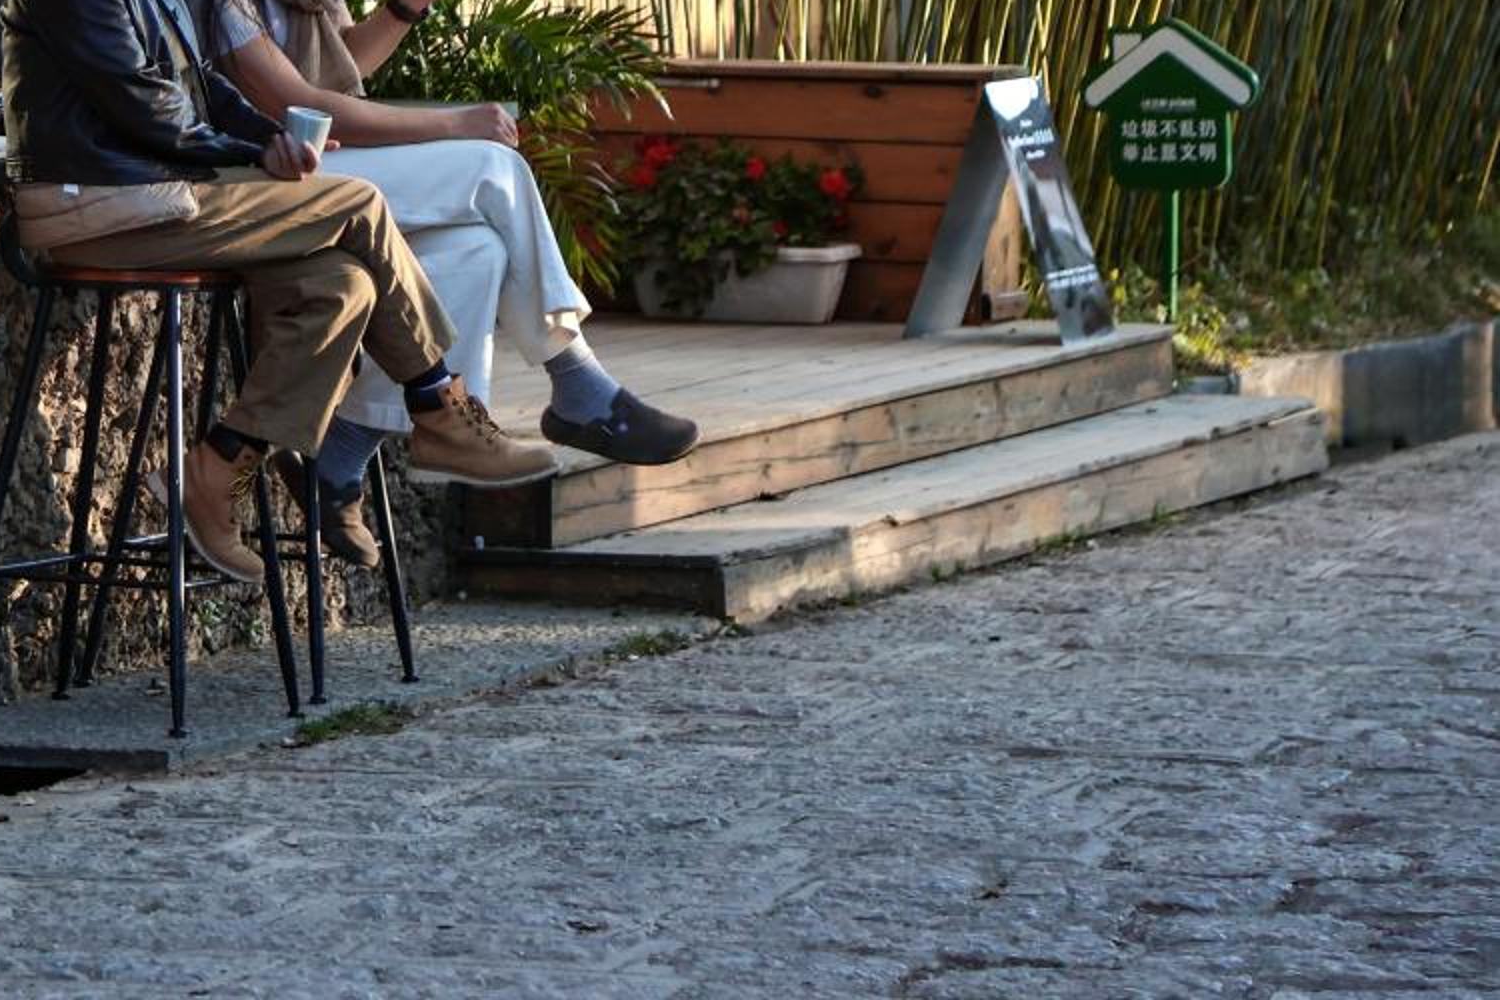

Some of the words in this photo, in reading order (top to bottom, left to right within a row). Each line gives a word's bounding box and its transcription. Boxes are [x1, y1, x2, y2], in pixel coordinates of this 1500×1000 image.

[1122, 119, 1217, 138] 垃圾不乱扔
